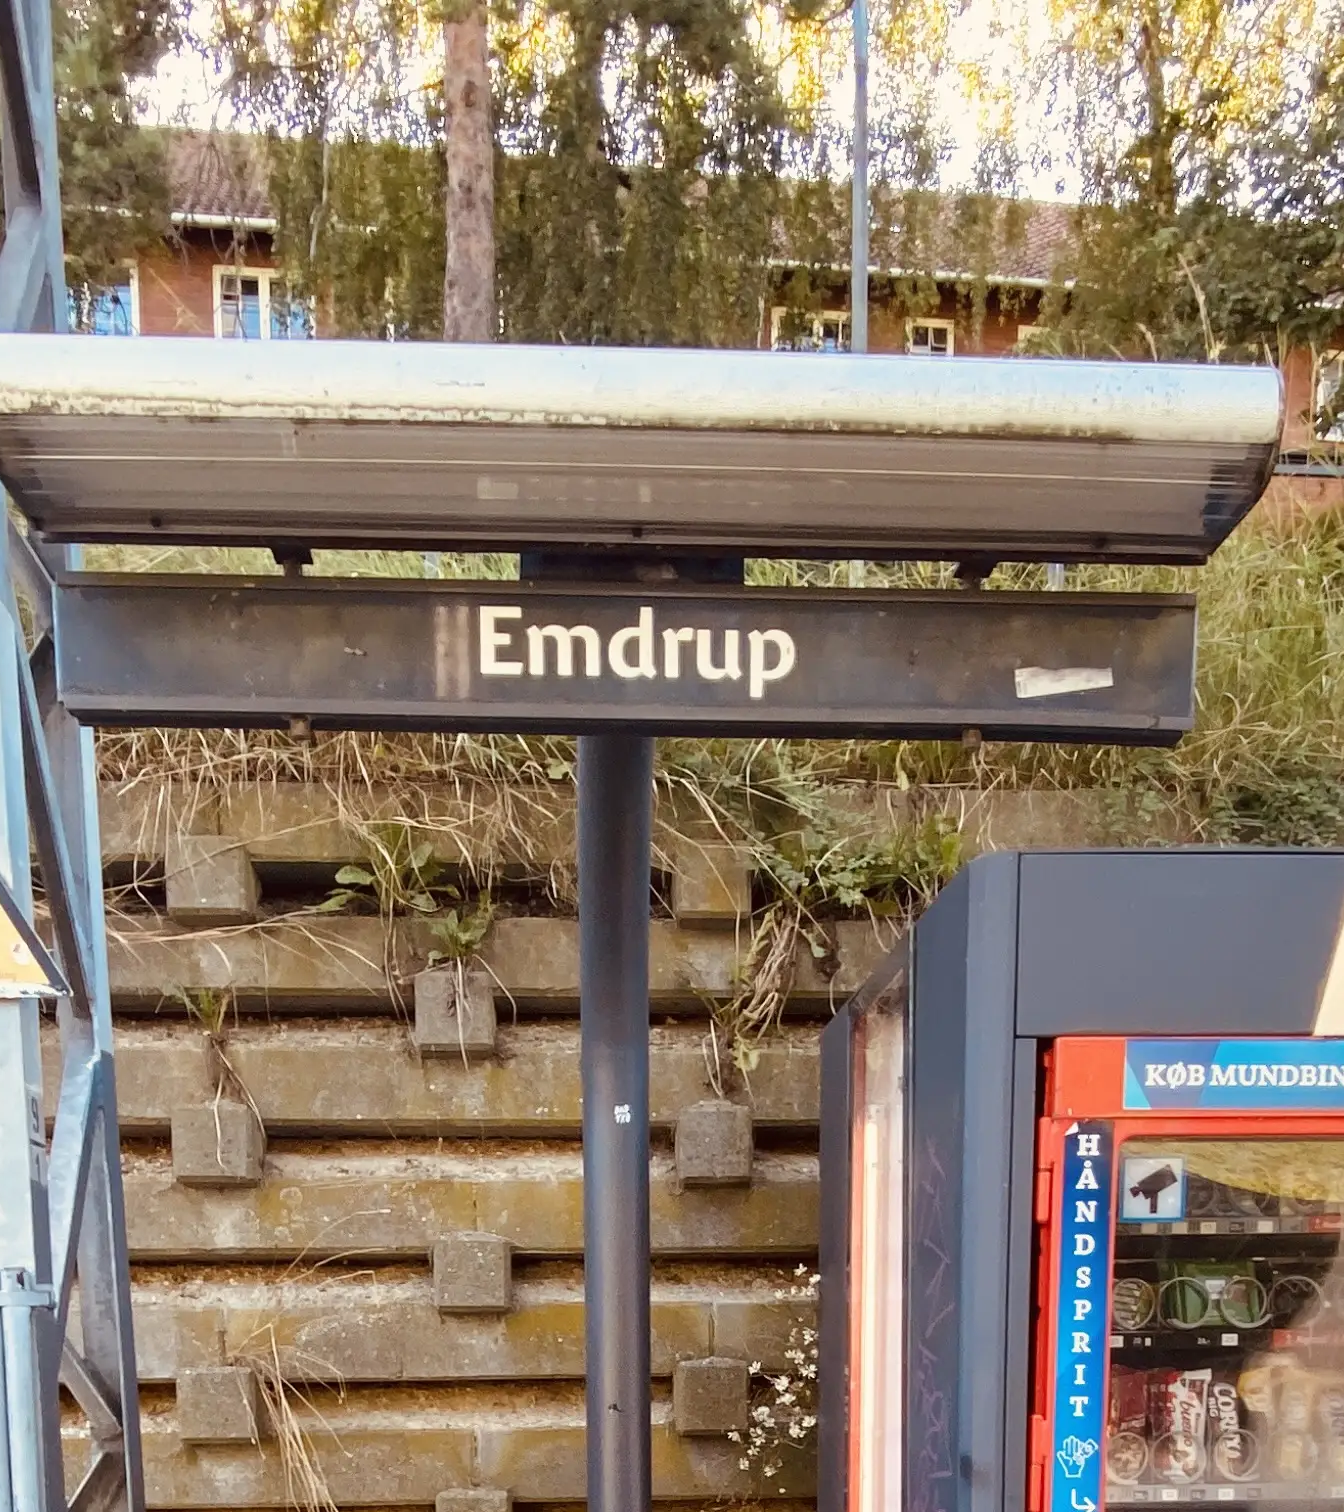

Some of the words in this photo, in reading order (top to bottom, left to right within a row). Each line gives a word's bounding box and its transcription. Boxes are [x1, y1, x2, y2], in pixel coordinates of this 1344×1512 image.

[480, 606, 796, 698] Emdrup
[1144, 1060, 1205, 1089] KØB
[1069, 1134, 1100, 1418] HÅNDSPRIT
